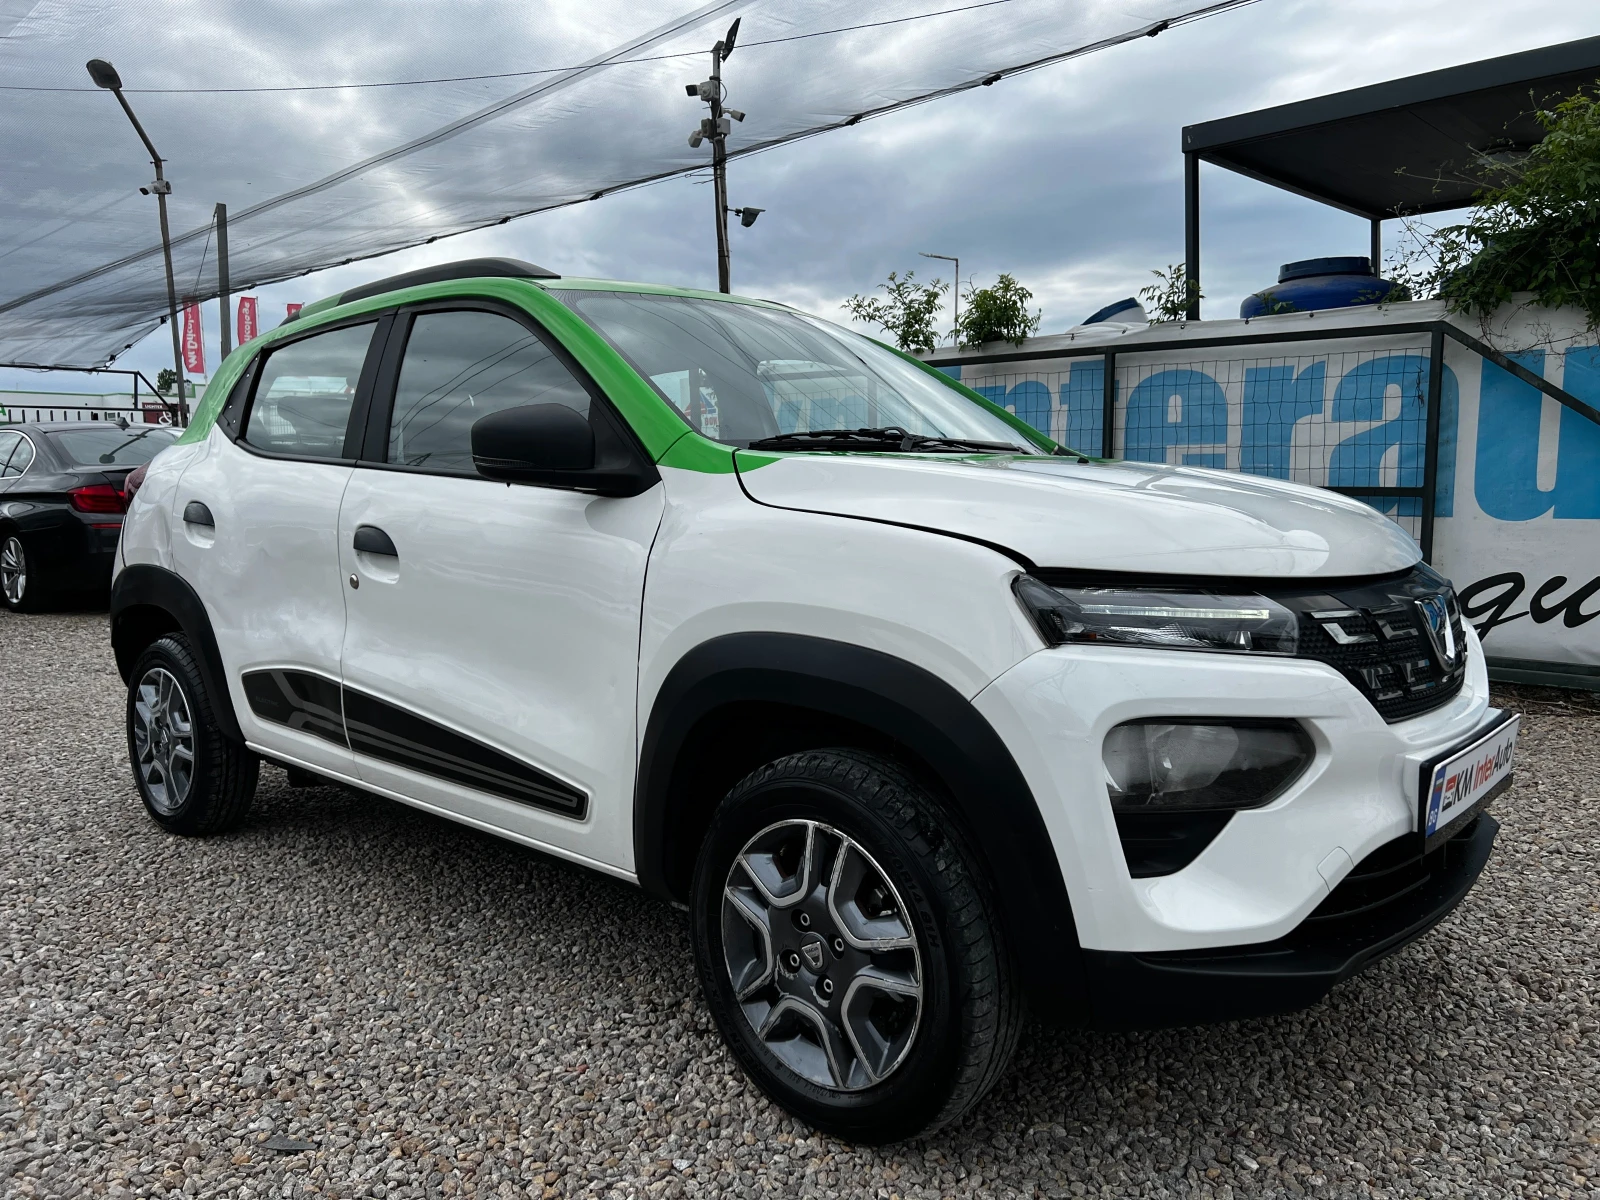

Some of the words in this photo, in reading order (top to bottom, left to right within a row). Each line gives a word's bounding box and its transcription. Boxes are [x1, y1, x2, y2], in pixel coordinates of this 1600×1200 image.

[935, 346, 1600, 521] nterau
[1453, 764, 1474, 806] KM
[1428, 808, 1438, 826] BG
